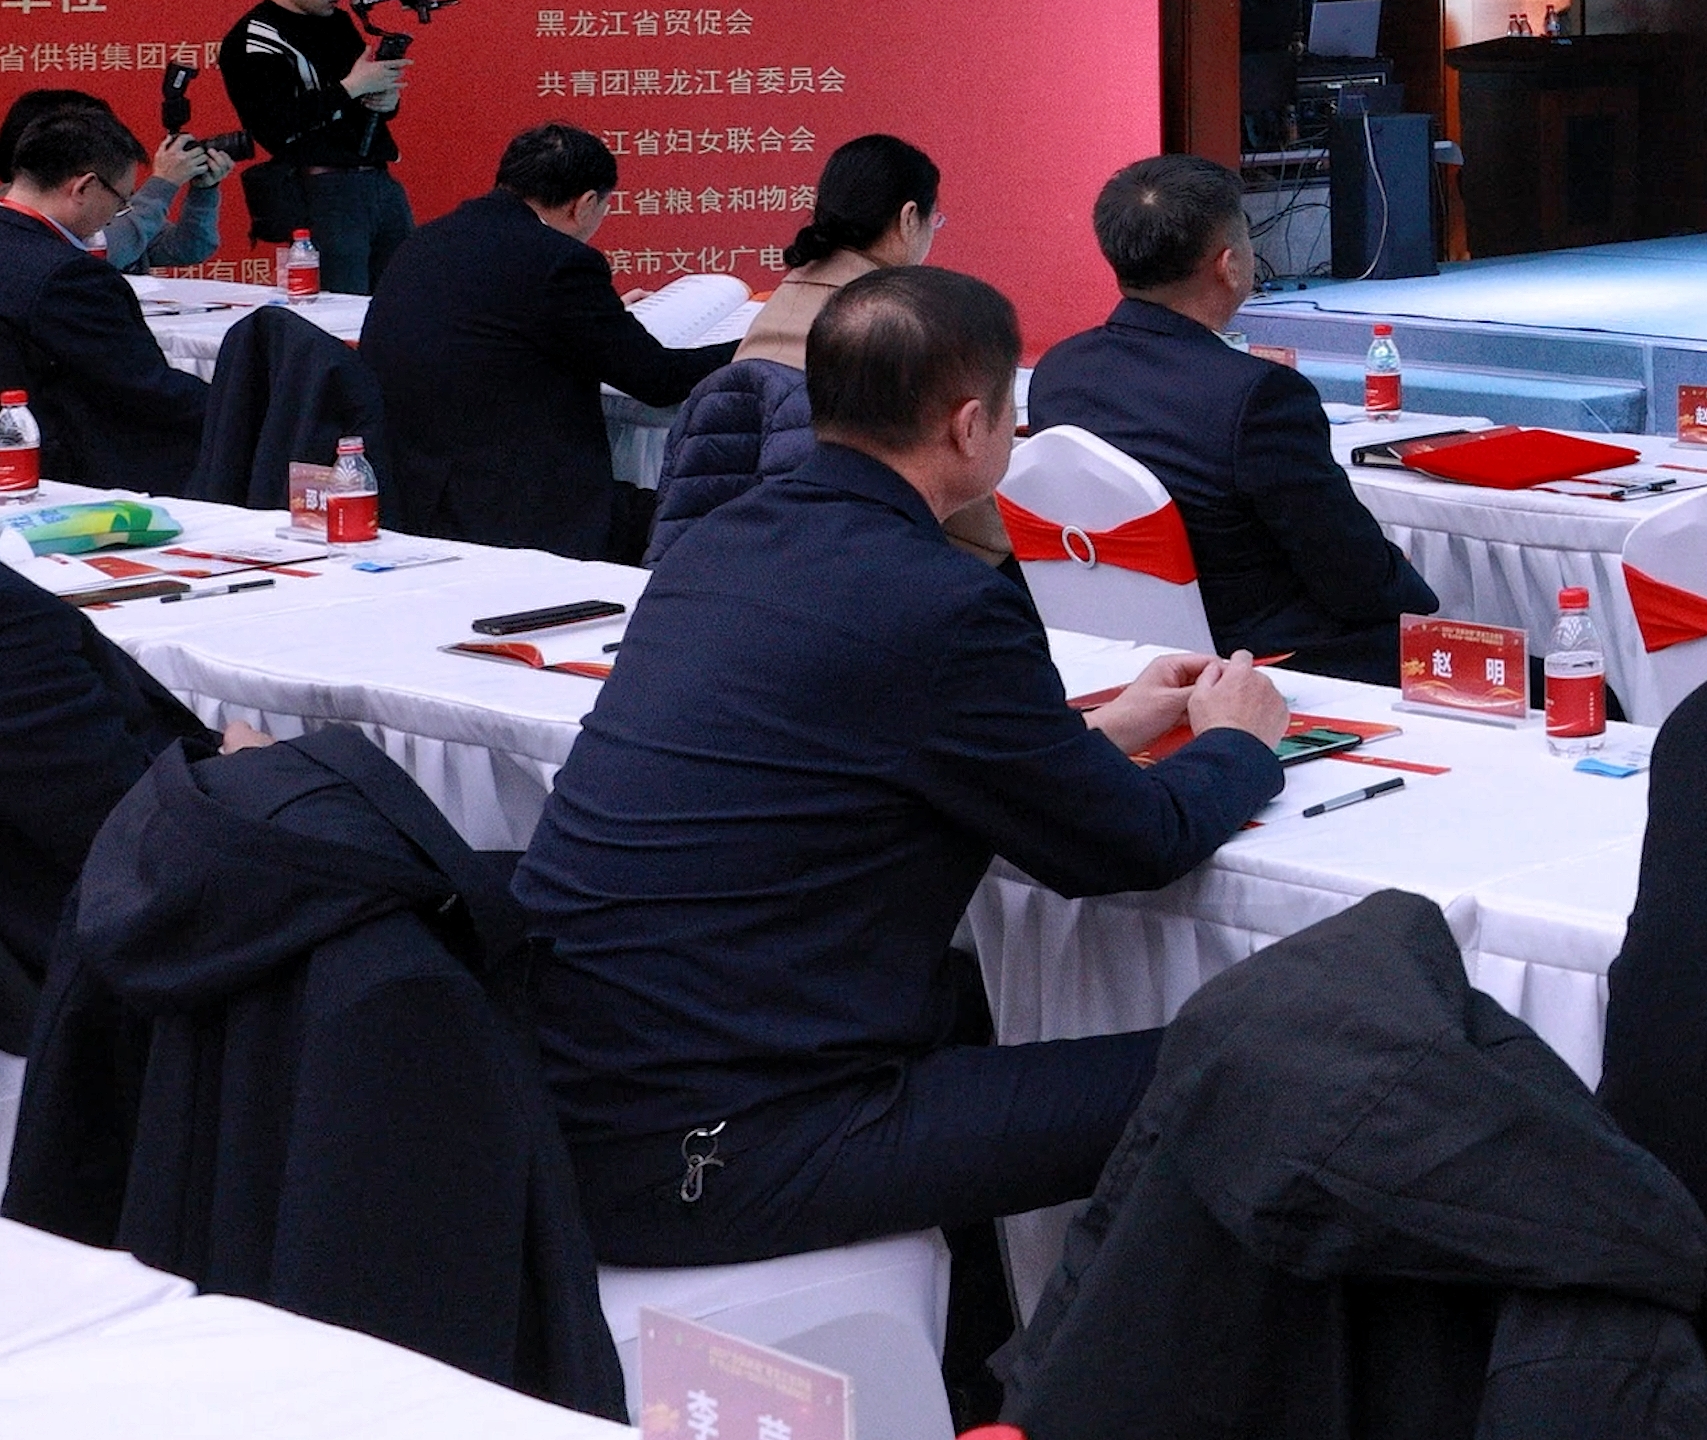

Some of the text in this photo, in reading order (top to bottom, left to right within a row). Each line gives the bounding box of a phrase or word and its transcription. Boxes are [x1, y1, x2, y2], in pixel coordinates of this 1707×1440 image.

[535, 8, 754, 39] 黑龙江省贸促会
[537, 65, 846, 98] 共青团黑龙江省委员会
